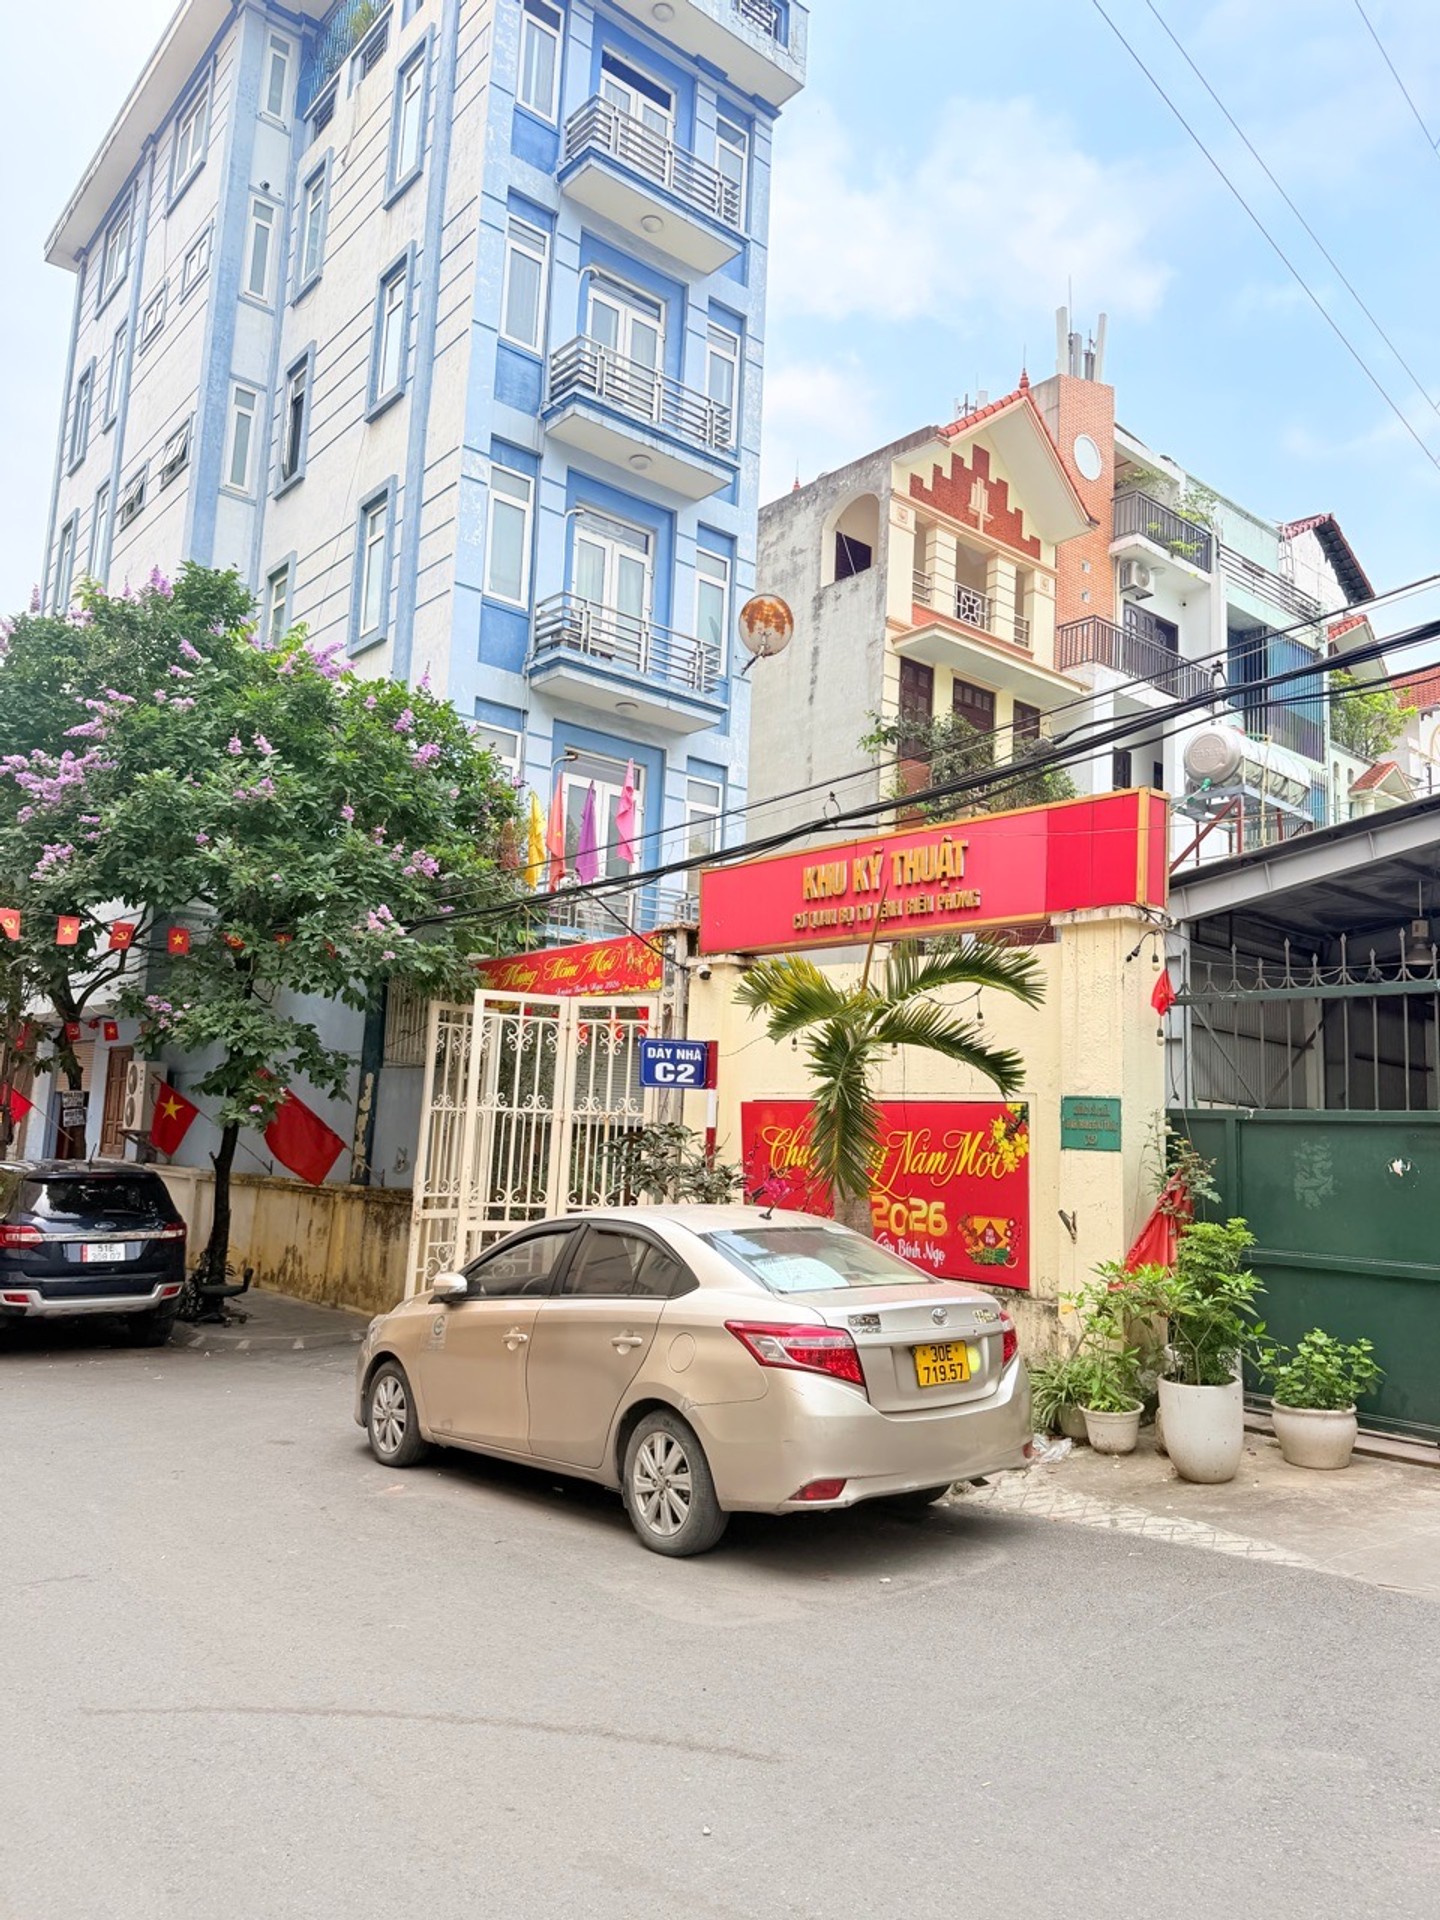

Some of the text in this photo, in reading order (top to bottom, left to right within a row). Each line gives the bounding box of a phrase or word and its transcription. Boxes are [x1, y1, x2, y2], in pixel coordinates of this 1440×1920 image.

[803, 834, 969, 900] KHU KỸ THUẬT
[809, 908, 838, 929] QUAN
[936, 886, 982, 911] PHÒNG
[676, 1047, 702, 1061] NHÀ
[655, 1062, 696, 1083] C2
[880, 1128, 953, 1186] Năm
[871, 1195, 948, 1237] 2026
[922, 1241, 946, 1268] Ngọ
[931, 1344, 954, 1363] 30E
[923, 1362, 964, 1385] 719.57
